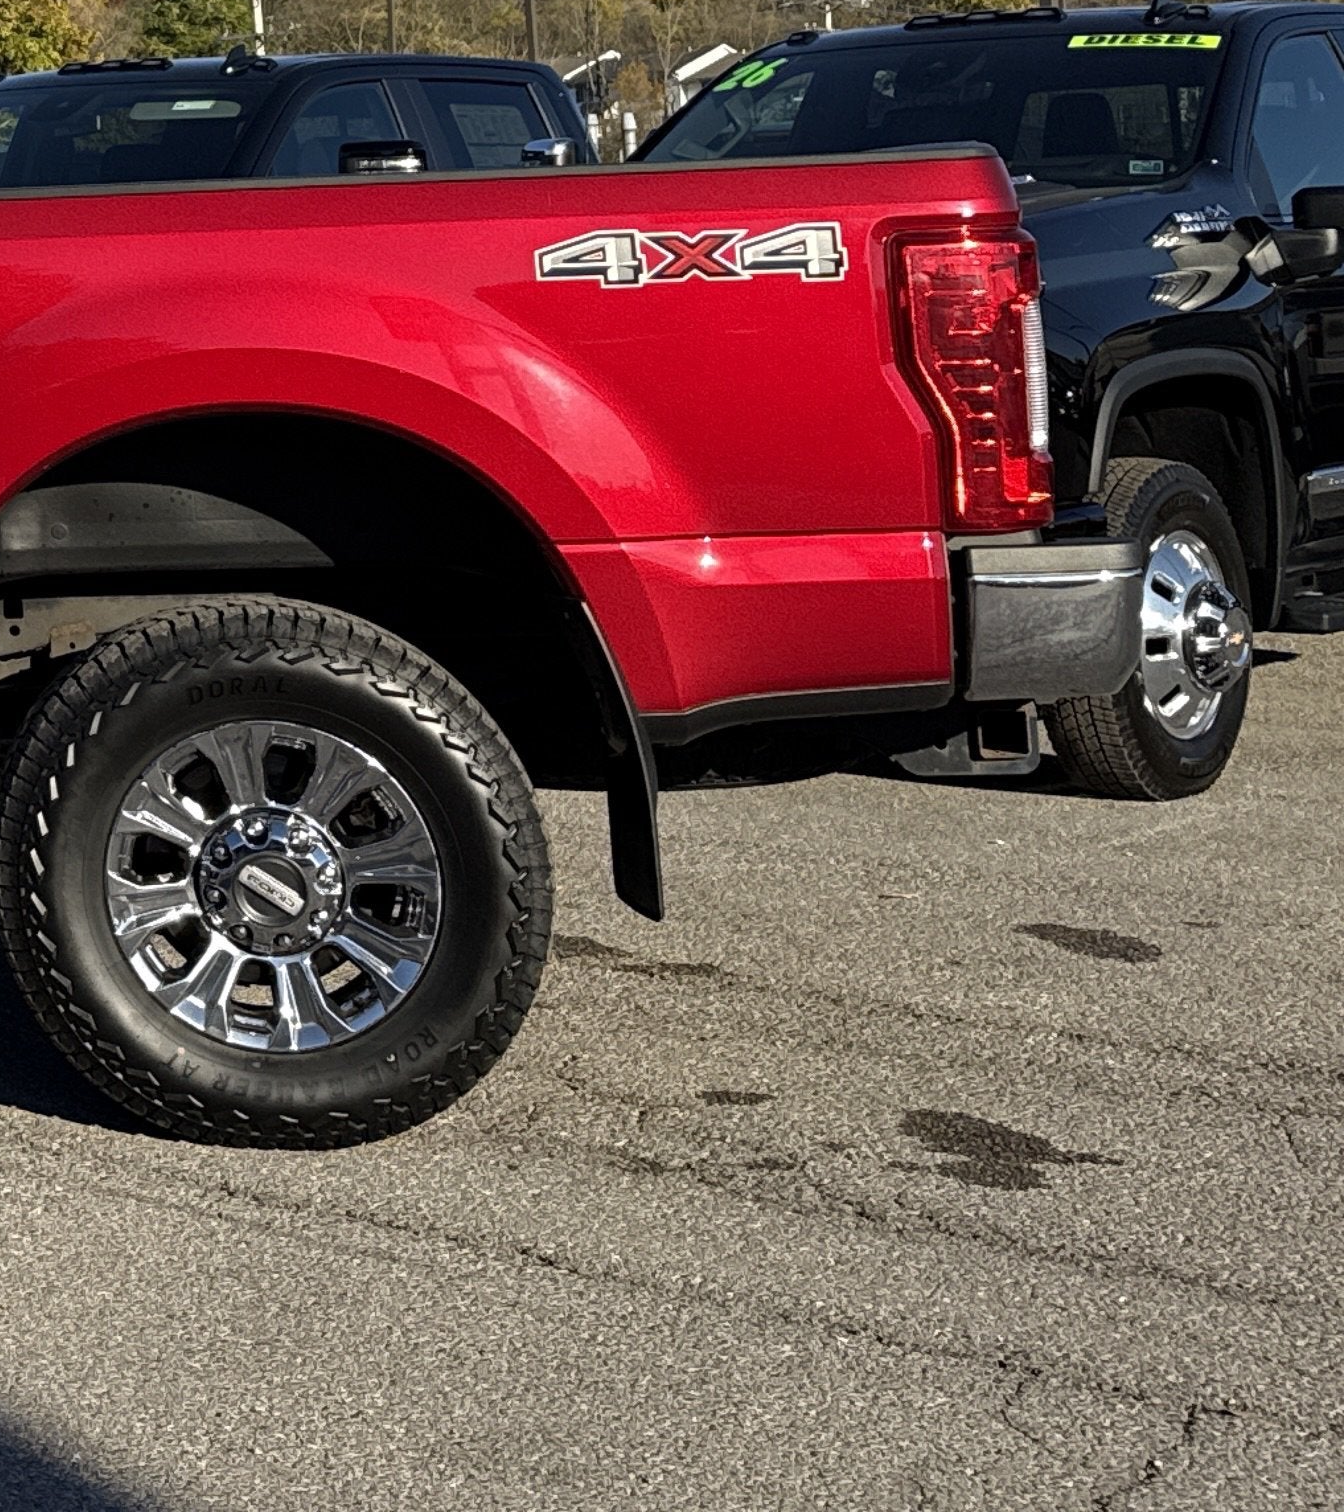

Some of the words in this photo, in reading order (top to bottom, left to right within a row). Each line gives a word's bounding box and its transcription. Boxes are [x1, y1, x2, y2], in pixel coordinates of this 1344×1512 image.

[1082, 33, 1209, 47] DIESEL
[712, 56, 790, 93] 26
[534, 221, 849, 289] 4X4
[186, 675, 289, 706] DORAL
[246, 873, 296, 909] FORD
